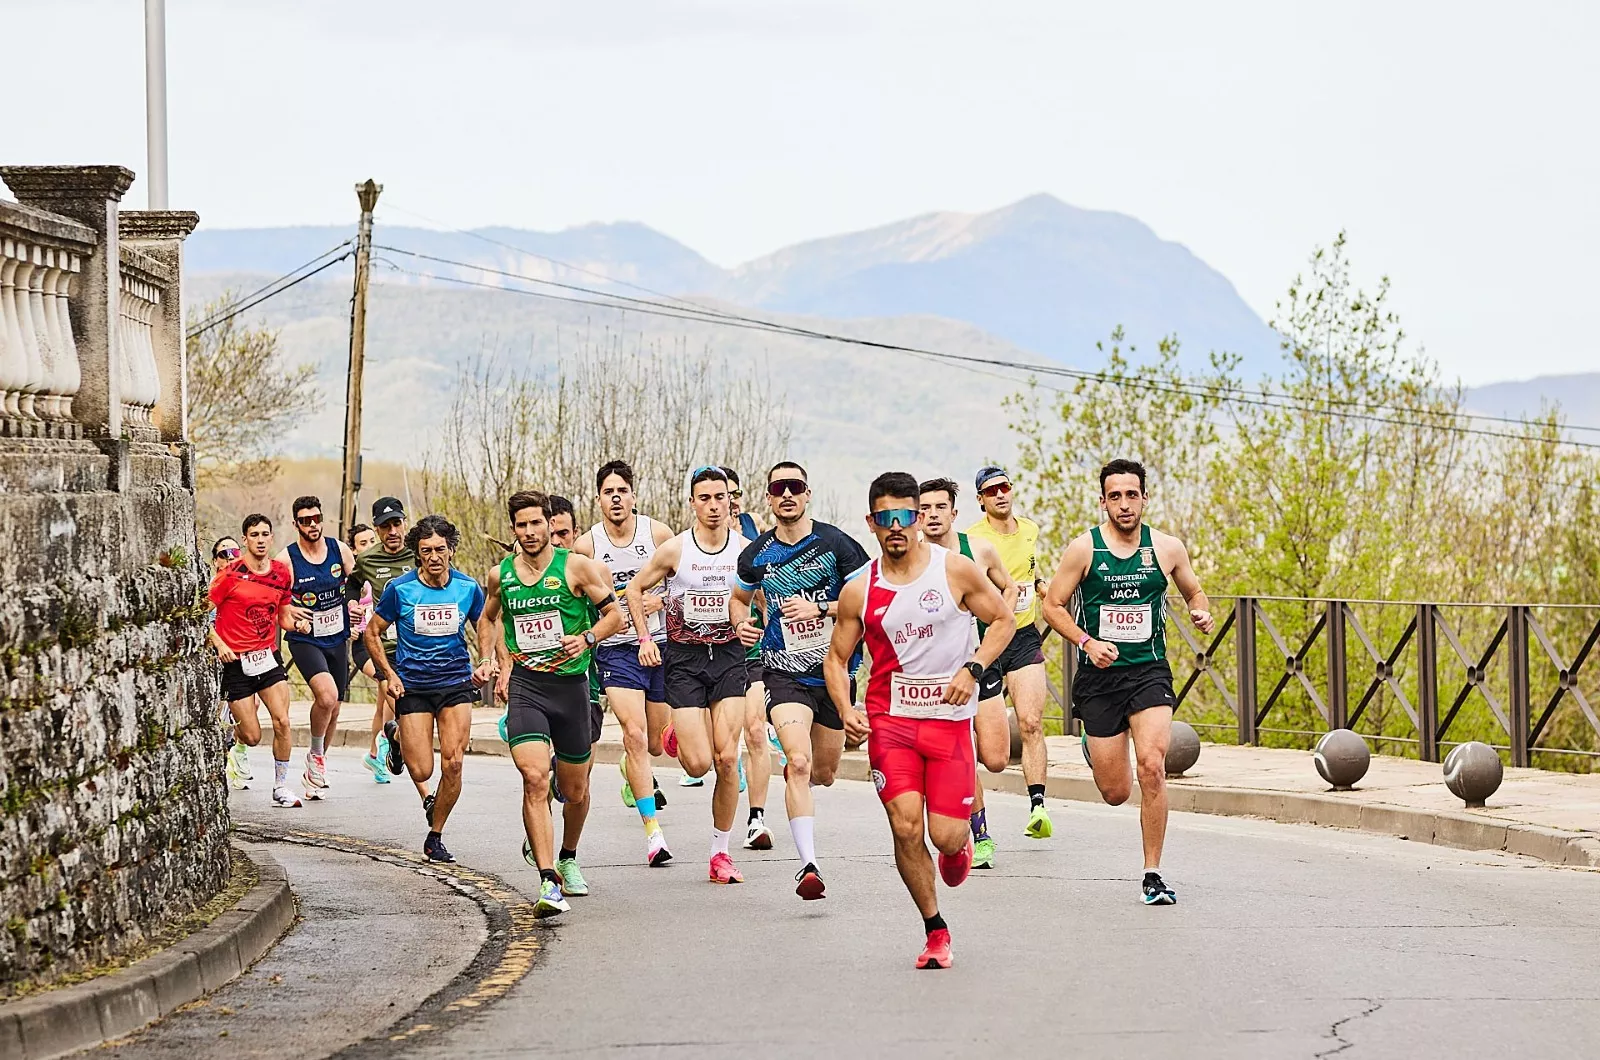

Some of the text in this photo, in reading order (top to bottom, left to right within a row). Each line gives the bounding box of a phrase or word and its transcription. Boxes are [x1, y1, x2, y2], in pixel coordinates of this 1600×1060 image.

[1104, 573, 1148, 582] FLORISTERIA
[318, 589, 335, 601] CEU
[1110, 588, 1140, 600] JACA
[507, 594, 561, 610] Huesca
[690, 596, 724, 607] 1039
[317, 611, 339, 625] 1005
[420, 610, 452, 621] 1615
[1106, 612, 1144, 624] 1063
[519, 618, 553, 634] 1210
[787, 618, 825, 635] 1055
[797, 631, 823, 641] ISMAEL
[897, 685, 943, 699] 1004
